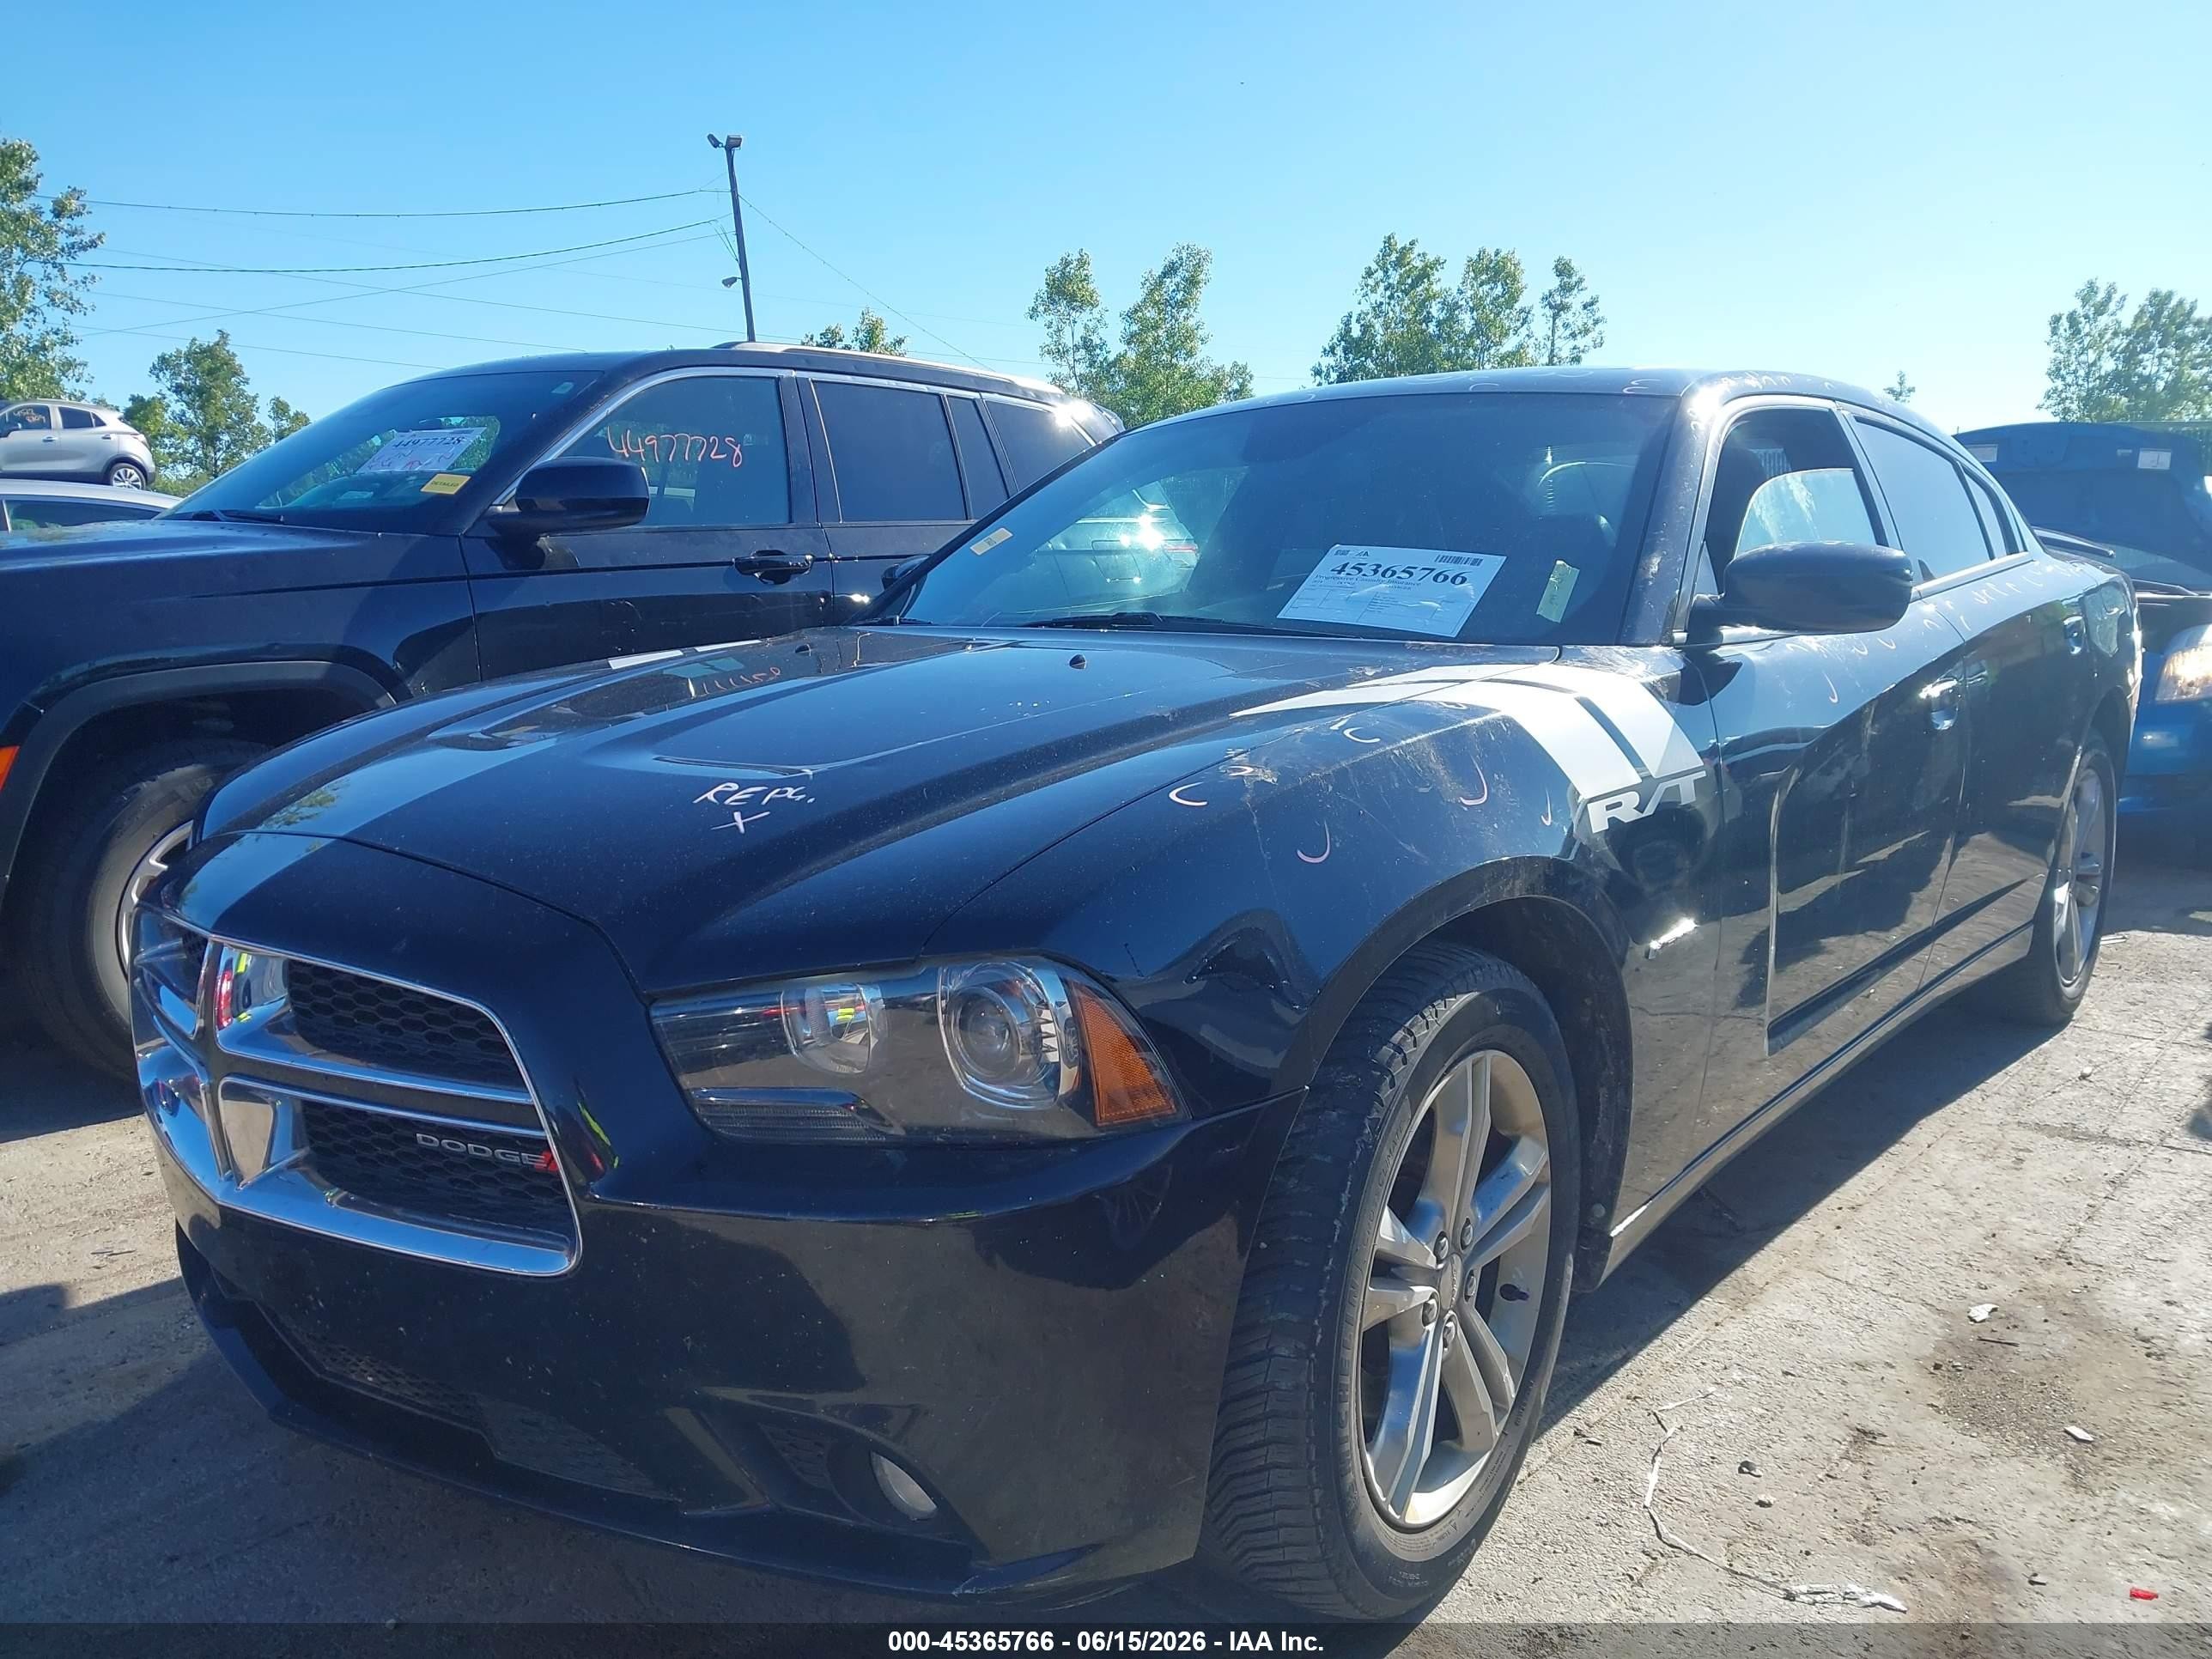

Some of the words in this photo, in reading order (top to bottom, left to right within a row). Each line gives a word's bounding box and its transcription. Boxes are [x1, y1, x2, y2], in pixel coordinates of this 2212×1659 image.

[607, 427, 743, 467] 44977728
[1330, 562, 1468, 586] 45365766
[1587, 770, 1706, 834] R/T
[416, 1133, 548, 1169] DODGE
